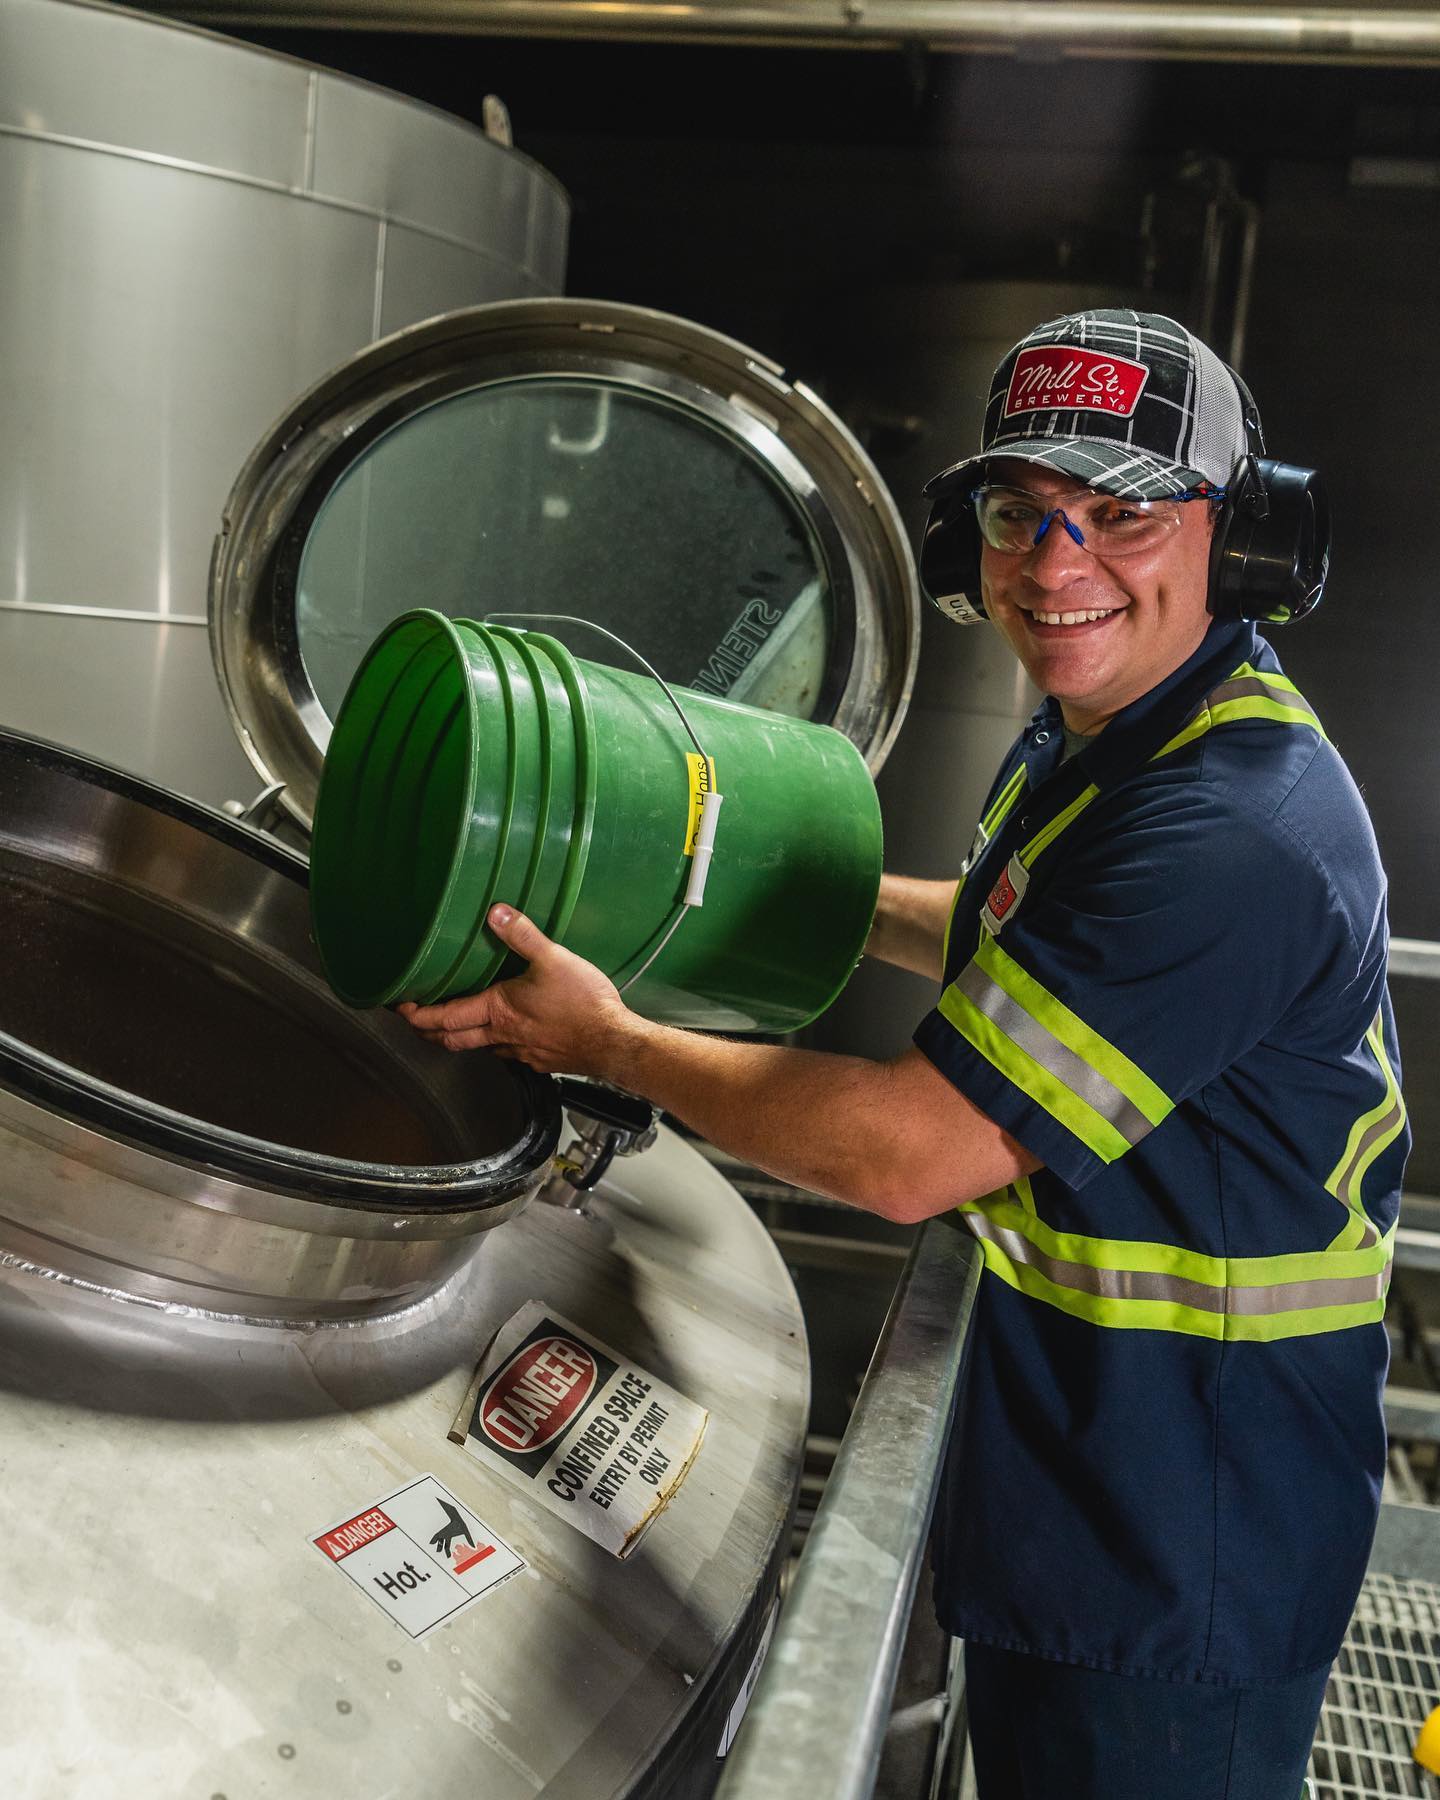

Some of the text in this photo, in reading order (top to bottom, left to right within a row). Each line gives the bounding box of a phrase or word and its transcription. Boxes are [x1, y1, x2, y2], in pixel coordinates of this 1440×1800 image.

[1018, 361, 1126, 396] Mill St.
[485, 1340, 592, 1447] DANGER
[547, 1372, 652, 1501] CONFINED SPACE
[588, 1401, 670, 1510] ENTRY BY PERMIT
[638, 1447, 672, 1485] ONLY
[334, 1511, 392, 1550] DANGER
[373, 1560, 432, 1600] Hot.
